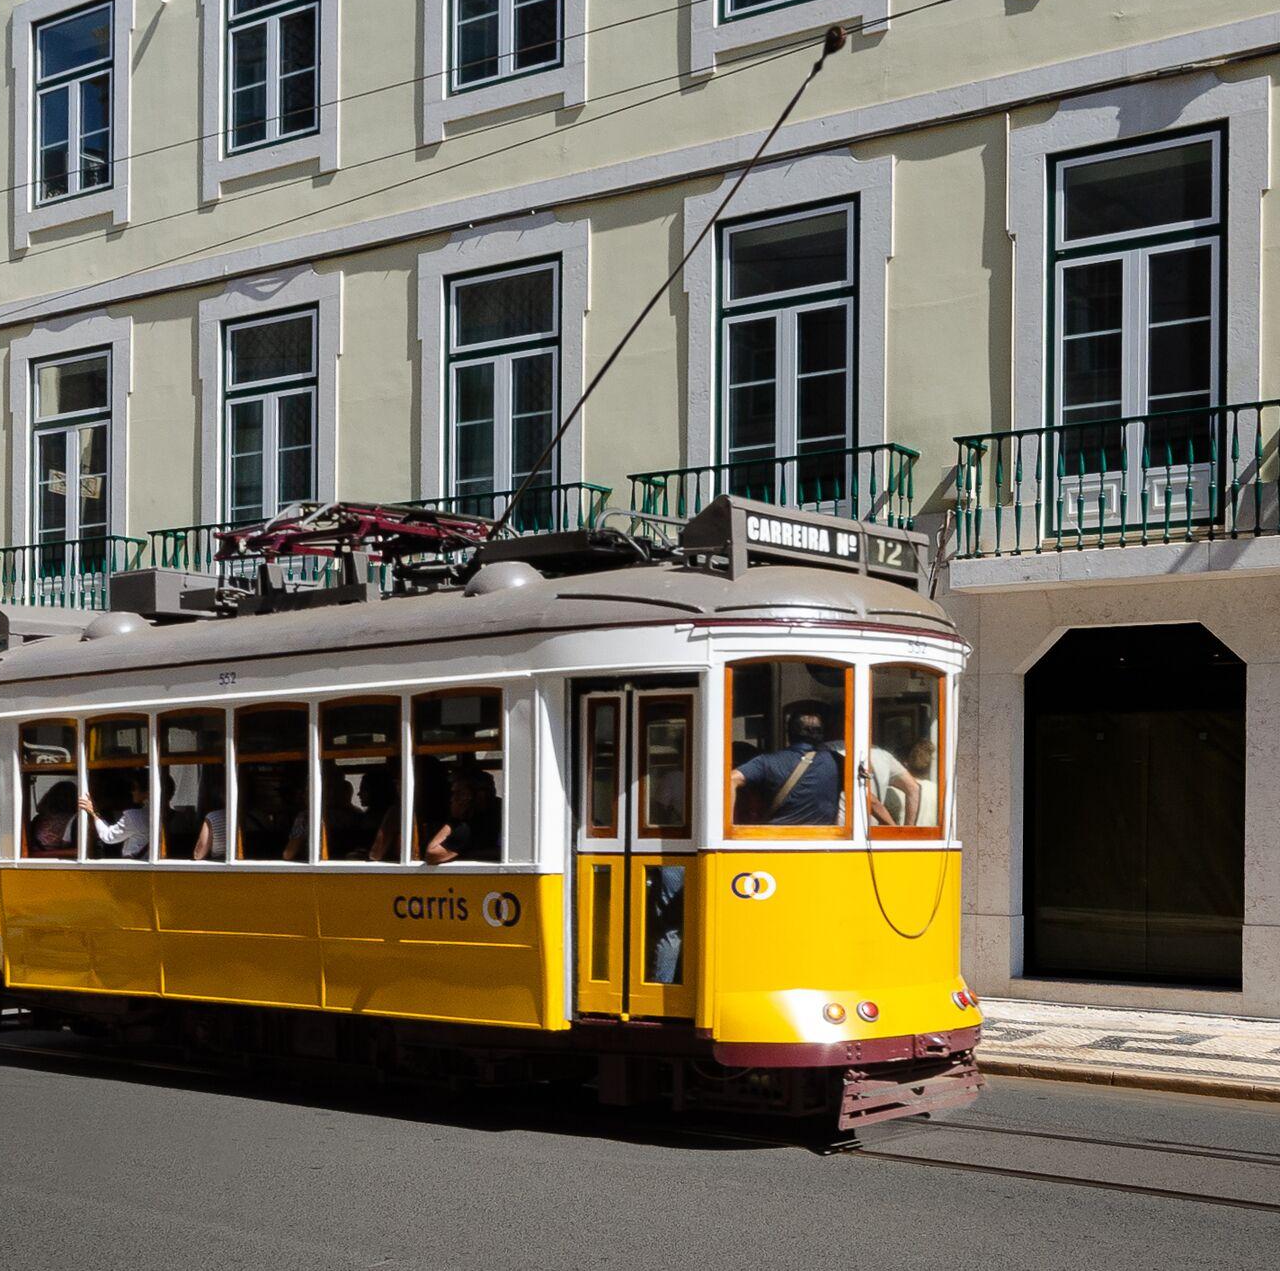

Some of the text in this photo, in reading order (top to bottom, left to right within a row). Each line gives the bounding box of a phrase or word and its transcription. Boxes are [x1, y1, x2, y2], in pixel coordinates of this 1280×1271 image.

[746, 515, 830, 553] CARREIRA
[876, 538, 903, 566] 12
[219, 671, 236, 685] 552
[393, 888, 469, 921] carris
